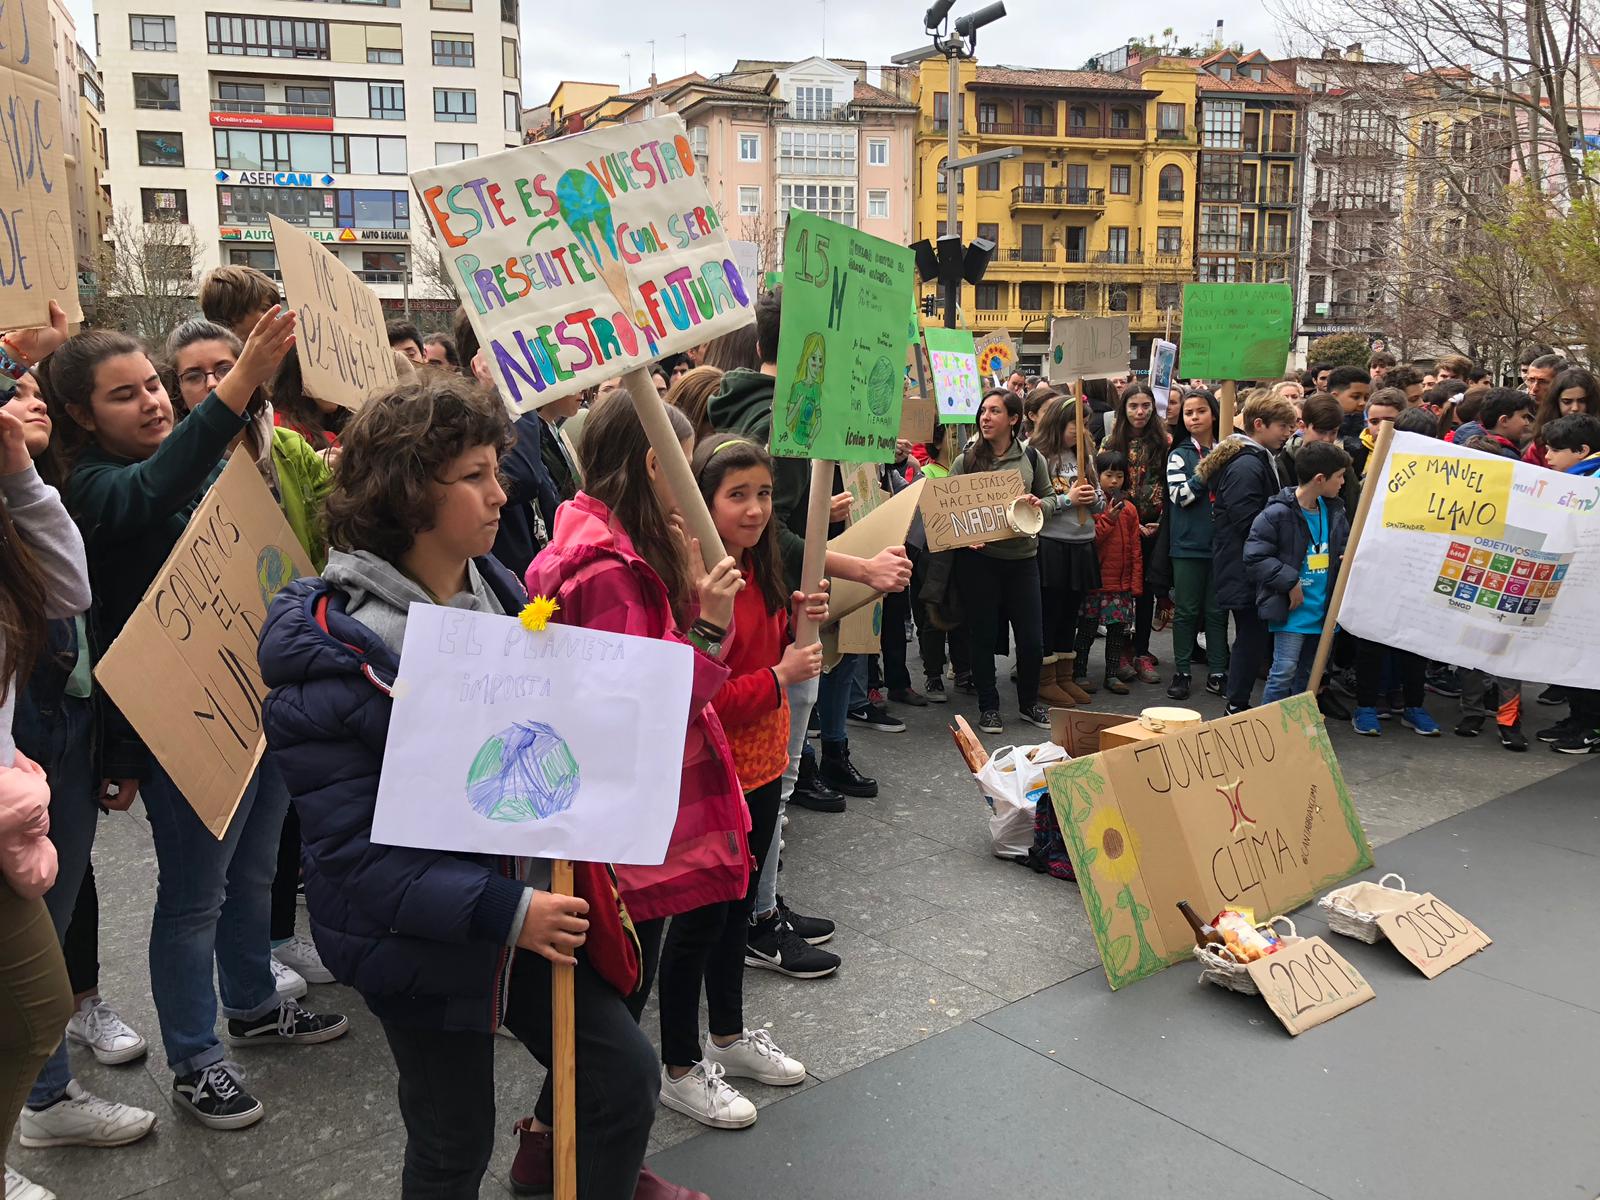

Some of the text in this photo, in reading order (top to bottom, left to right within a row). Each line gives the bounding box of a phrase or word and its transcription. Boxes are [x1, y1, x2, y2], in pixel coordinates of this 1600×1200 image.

[239, 171, 313, 187] ASEFICAN
[423, 134, 696, 248] ESTE ES VUESTRO
[361, 230, 409, 240] AUTO ESCUELA
[795, 228, 830, 288] 15
[455, 242, 596, 315] PRESENTE
[616, 222, 669, 264] CUAL
[490, 258, 750, 402] NUESTRO FUTURO
[933, 475, 1006, 497] NO ESTÁIS
[1426, 459, 1484, 493] MANUEL
[939, 493, 1009, 508] HACIENDO
[950, 503, 1009, 538] NADA
[1428, 493, 1497, 530] LLANO
[1474, 537, 1530, 558] OBJETIVOS
[155, 504, 240, 641] SALVEMOS
[211, 588, 241, 631] EL
[438, 611, 625, 662] EL PLANETA
[1212, 828, 1298, 902] CLIMA
[1395, 899, 1469, 958] 2050
[1269, 943, 1358, 1015] 2019
